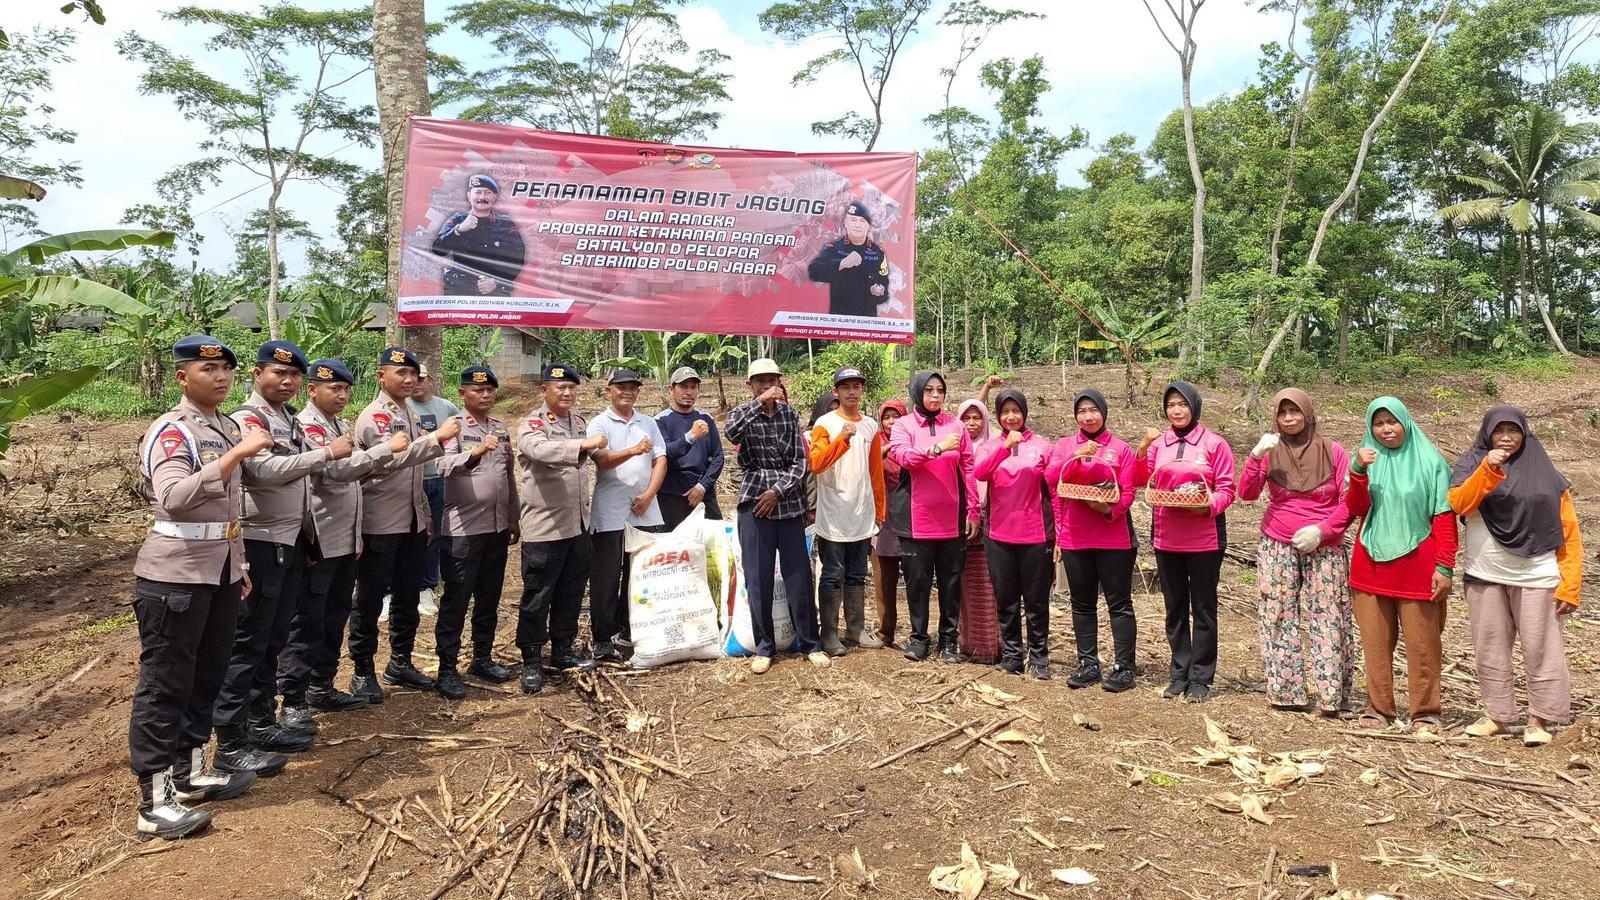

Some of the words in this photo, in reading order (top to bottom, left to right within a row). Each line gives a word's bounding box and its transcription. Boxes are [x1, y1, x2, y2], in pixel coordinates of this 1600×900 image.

[512, 181, 664, 204] PENANAMAN
[671, 190, 732, 208] BIBIT
[736, 195, 826, 215] JAGUNG
[604, 209, 664, 224] DALAM
[669, 212, 736, 228] RANGKA
[538, 222, 622, 237] PROGRAM
[626, 226, 727, 243] KETAHANAN
[730, 231, 797, 247] PANGAN
[576, 239, 666, 255] BATALYON
[669, 243, 682, 256] D
[685, 244, 760, 259] PELOPOR
[560, 254, 660, 270] SATBRIMOB
[663, 259, 719, 273] POLDA
[721, 261, 777, 276] JABAR
[641, 549, 691, 570] UREA
